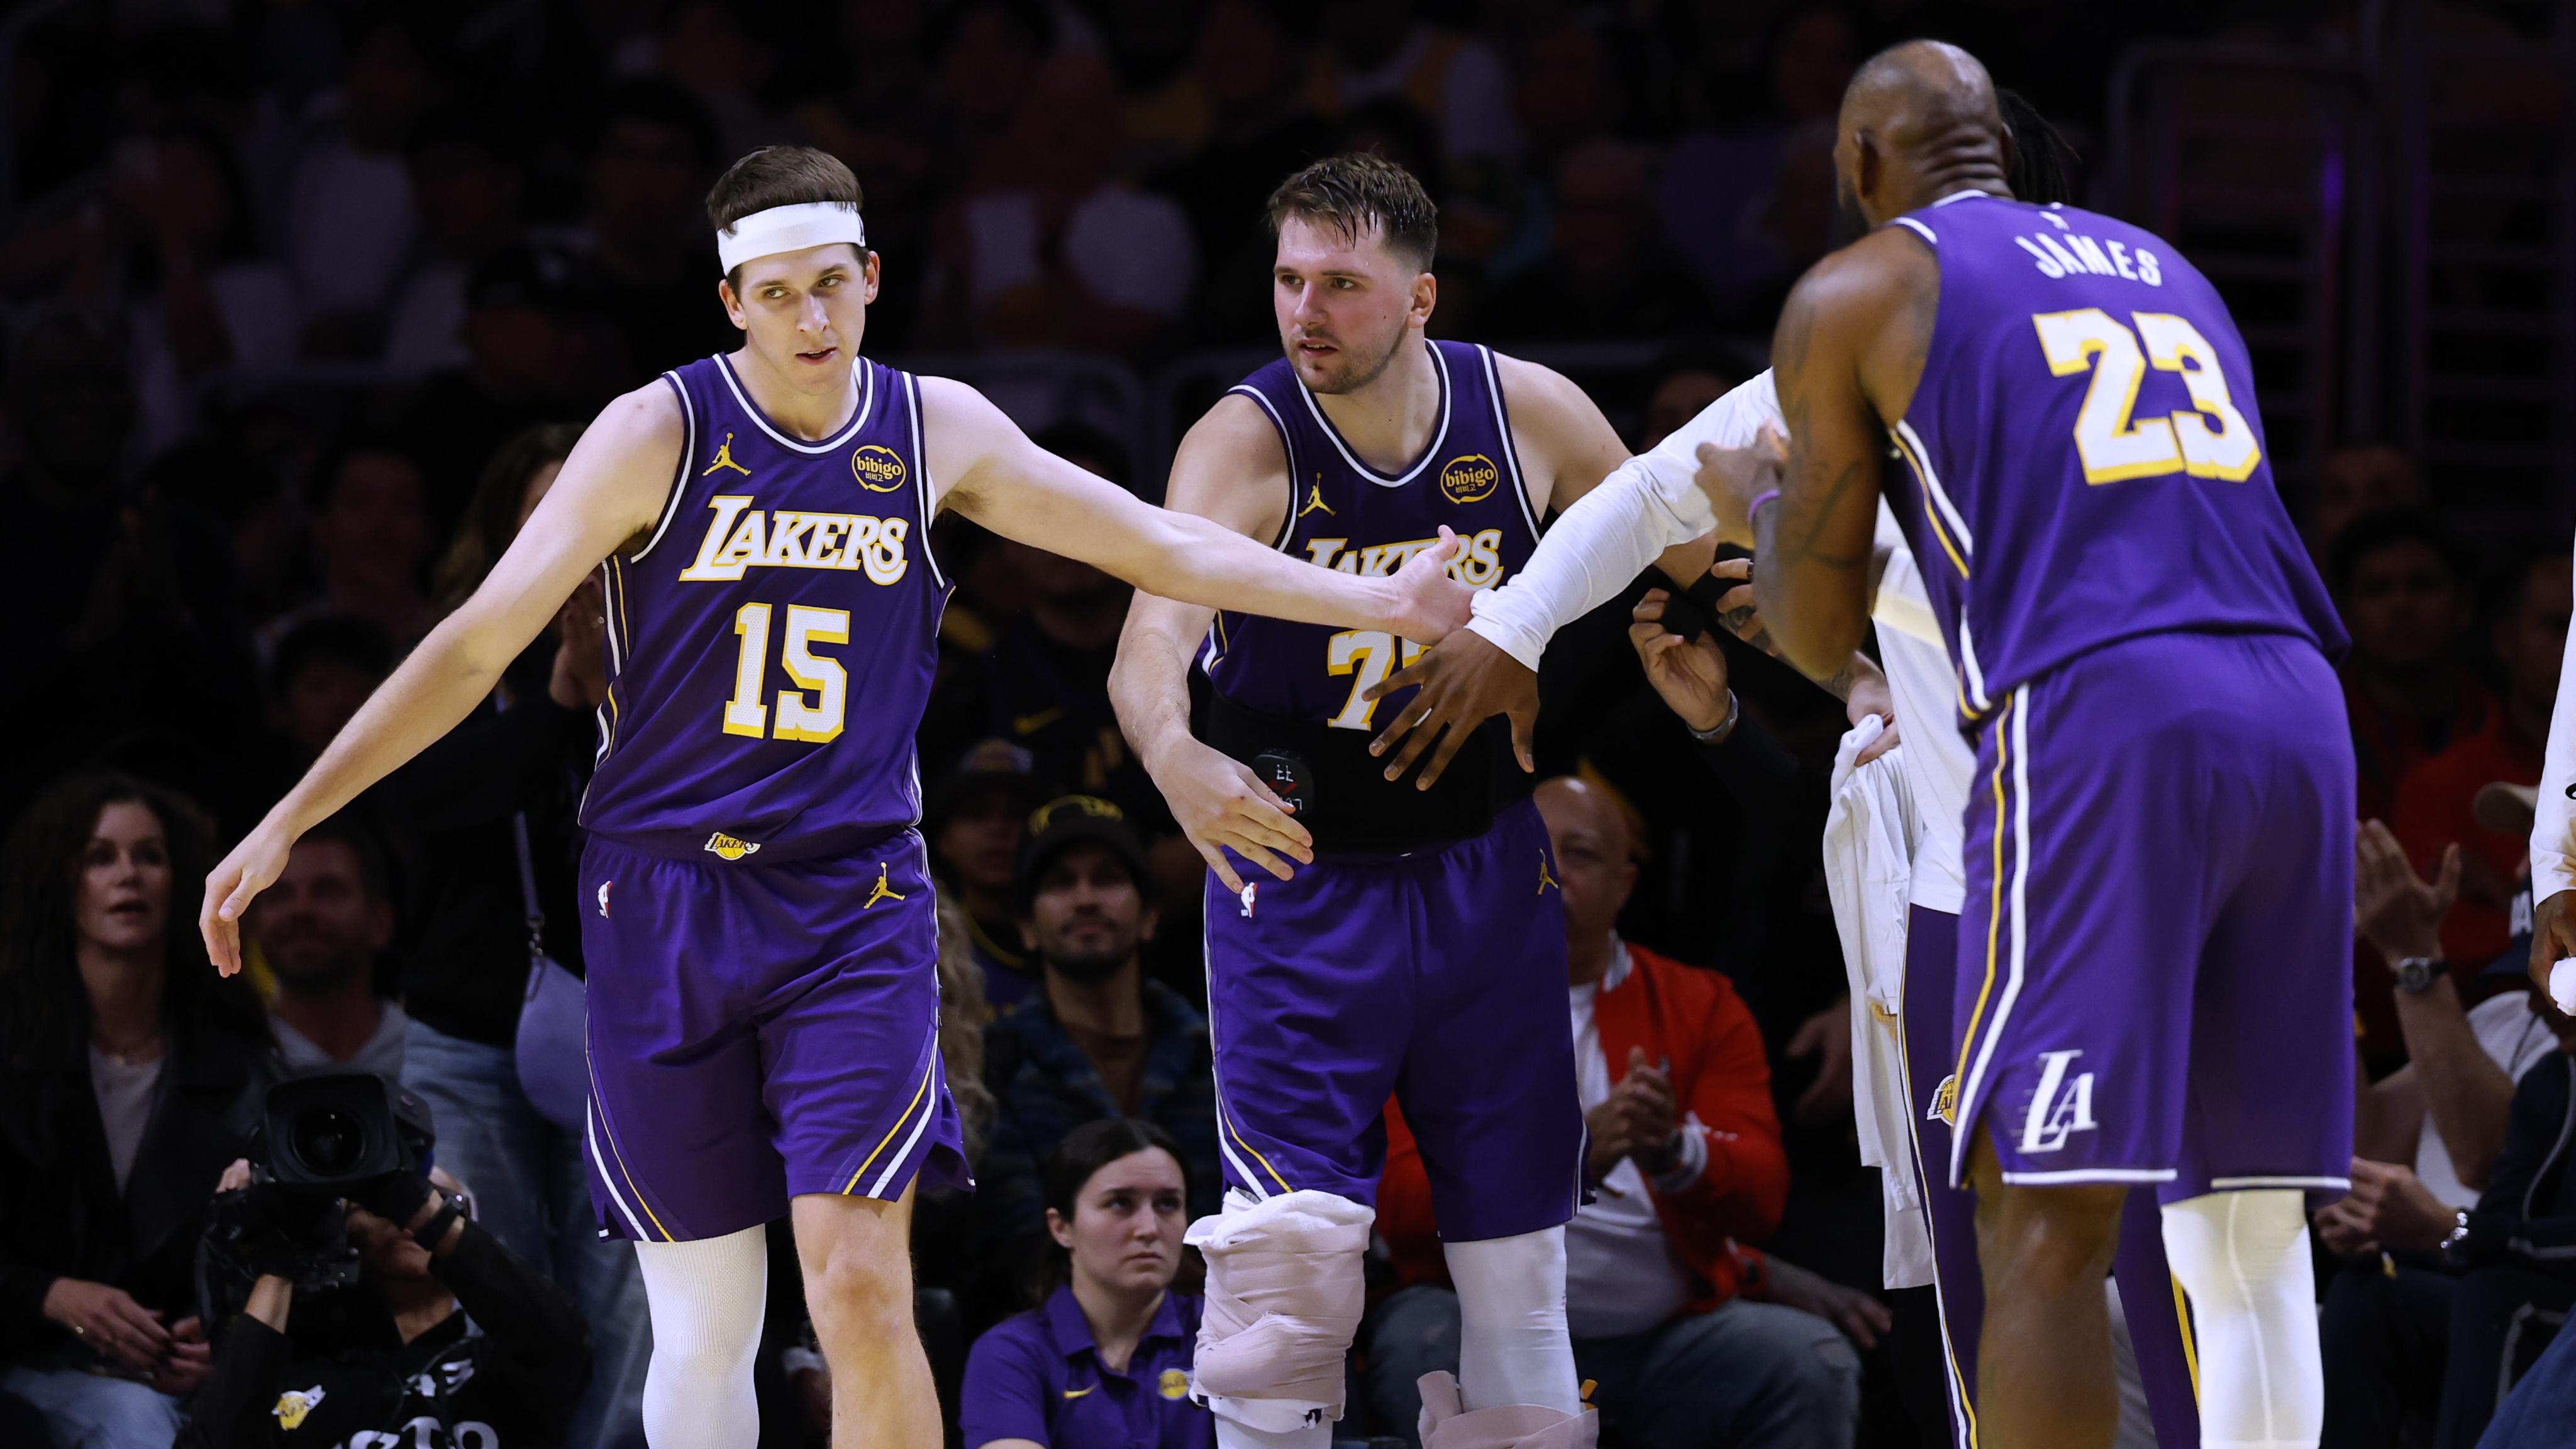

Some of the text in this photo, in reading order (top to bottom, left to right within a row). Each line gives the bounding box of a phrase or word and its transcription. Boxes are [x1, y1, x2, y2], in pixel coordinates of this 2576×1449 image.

[2014, 233, 2162, 286] JAMES
[2032, 308, 2262, 486] 23
[857, 456, 902, 480] bibigo
[1445, 467, 1495, 487] bibigo
[679, 495, 909, 586] LAKERS
[1305, 528, 1505, 590] KRS
[722, 602, 850, 743] 15
[2015, 1048, 2099, 1154] LA
